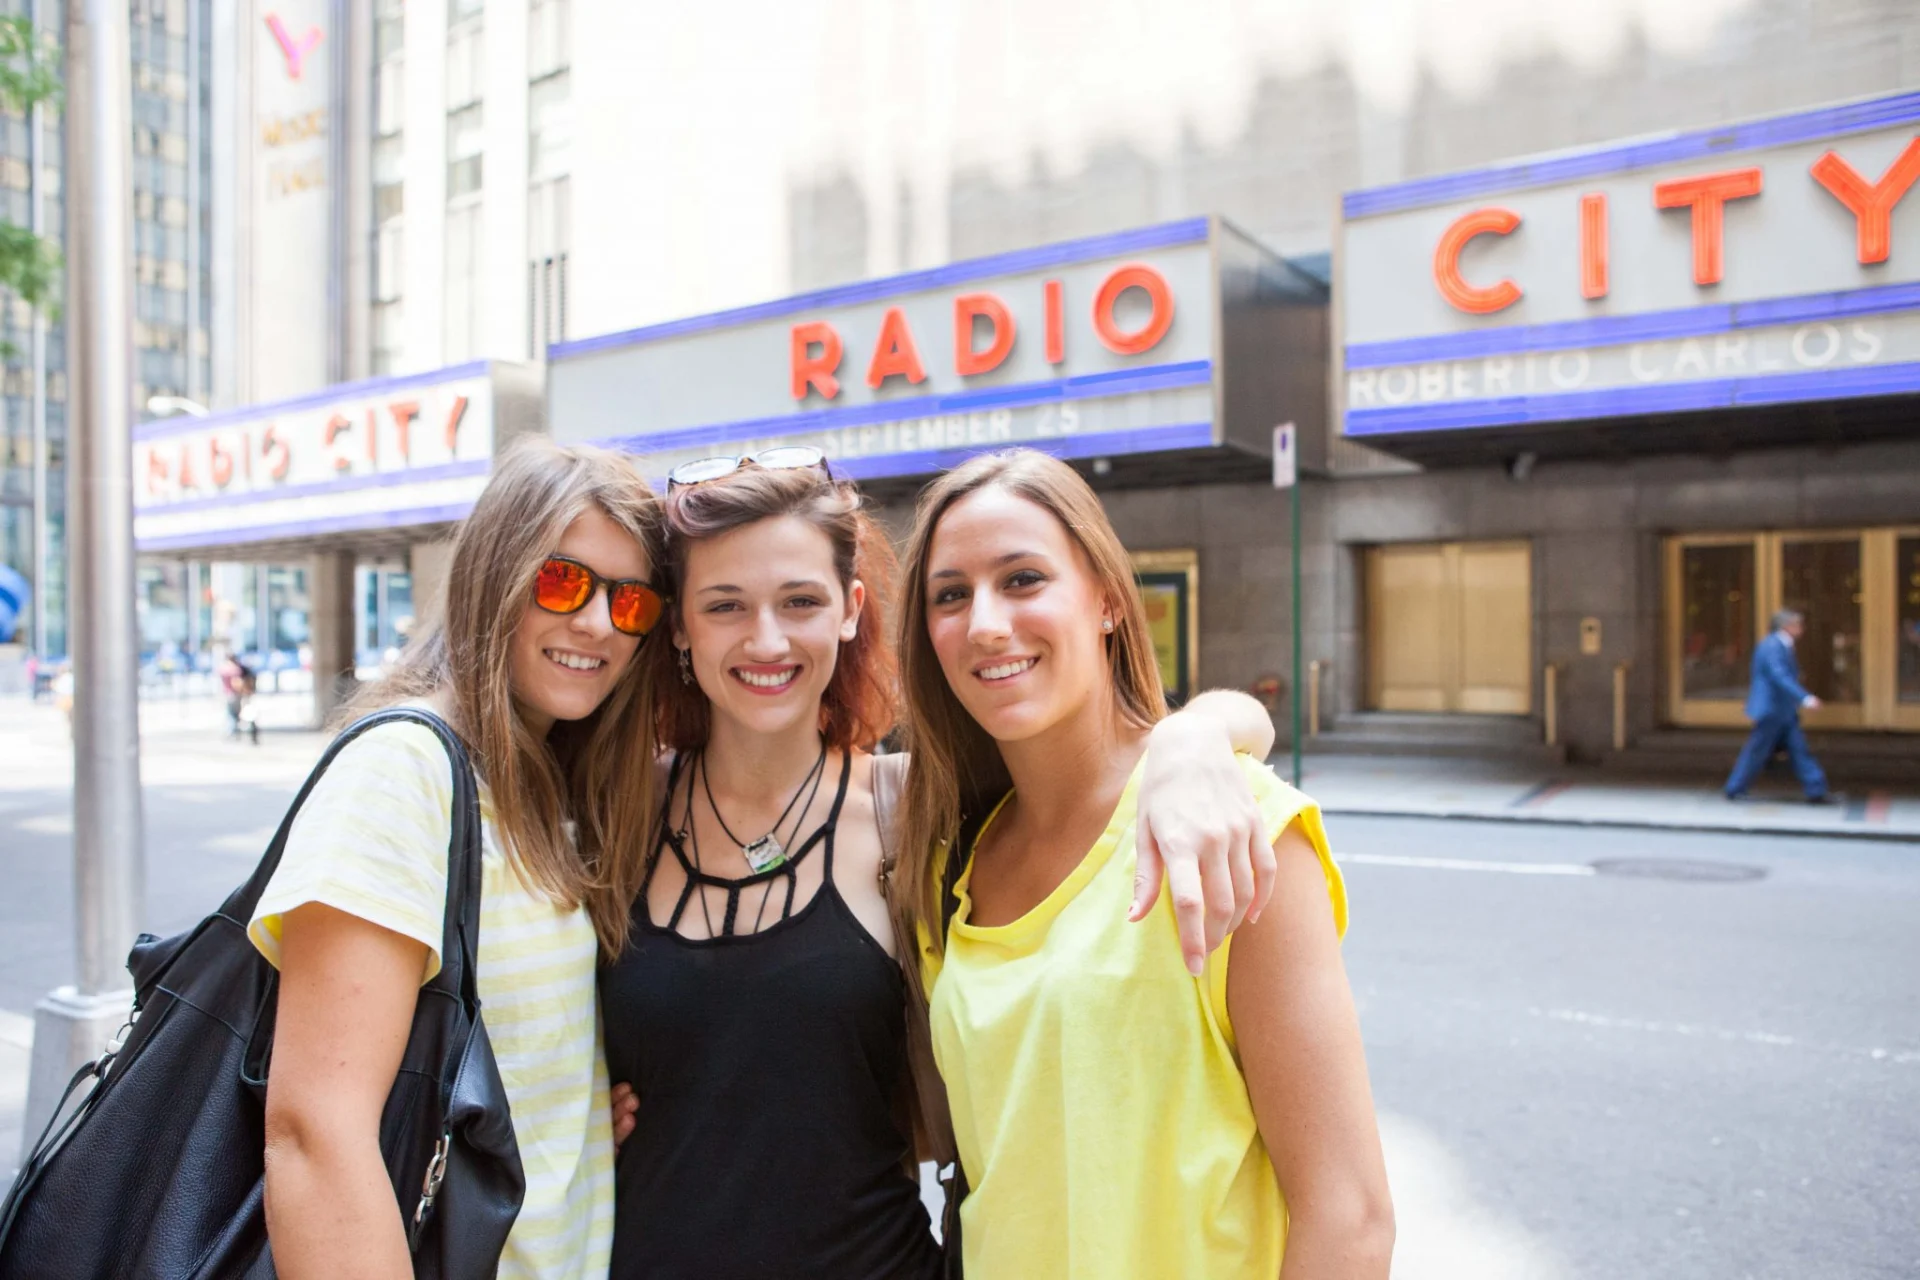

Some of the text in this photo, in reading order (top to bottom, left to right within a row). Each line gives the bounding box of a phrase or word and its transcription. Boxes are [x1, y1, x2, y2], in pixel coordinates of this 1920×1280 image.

[1432, 136, 1920, 315] CITY
[789, 261, 1175, 400] RADIO
[1348, 322, 1884, 406] ROBERTO CARLOS
[822, 409, 1013, 457] SEPTEMBER
[1036, 401, 1081, 436] 25
